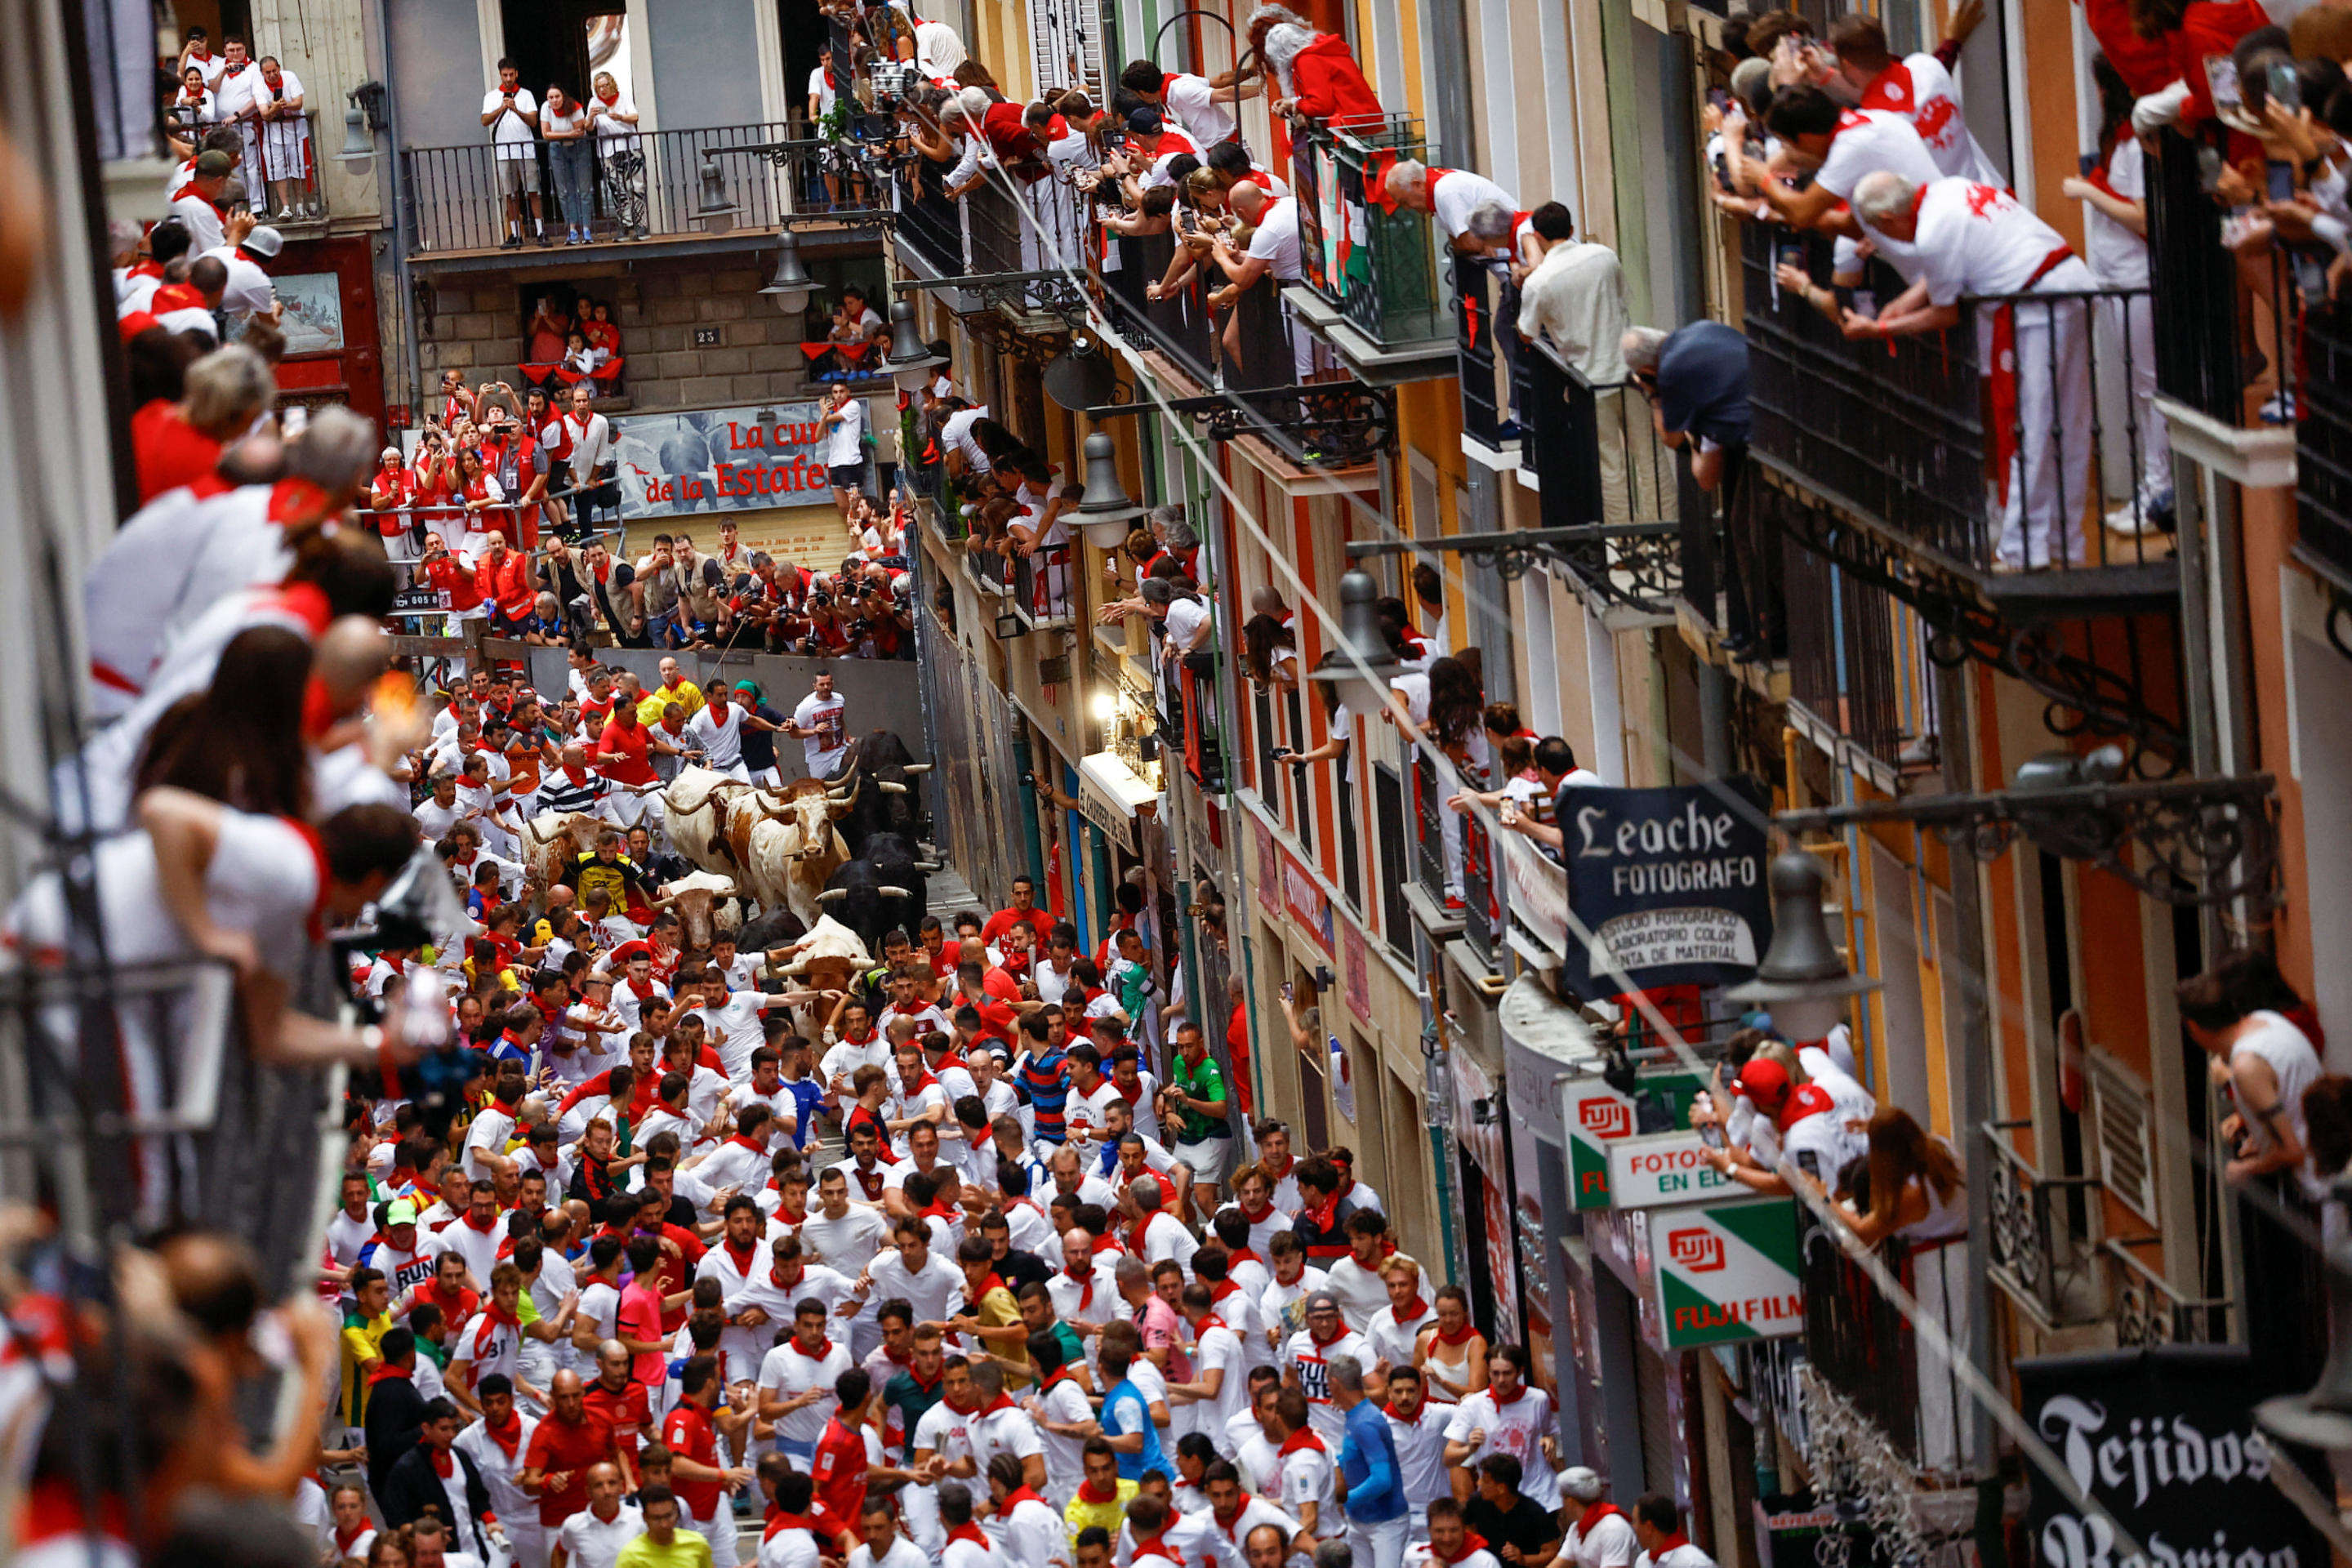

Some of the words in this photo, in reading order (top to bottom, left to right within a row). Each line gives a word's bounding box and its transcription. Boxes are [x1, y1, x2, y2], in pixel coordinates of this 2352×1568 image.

[728, 421, 764, 450] La
[773, 421, 823, 447] cur
[646, 478, 673, 502] de
[680, 475, 703, 500] la
[1577, 799, 1735, 858] Leache
[1612, 856, 1757, 896] FOTOGRAFO
[1606, 927, 1688, 955] LABORATORIO
[1694, 927, 1736, 944] COLOR
[1651, 946, 1668, 963] DE
[1676, 942, 1738, 963] MATERIAL
[1579, 1096, 1631, 1139] FUJI
[1659, 1174, 1688, 1193] EN
[1668, 1227, 1726, 1273] FUJI
[396, 1260, 434, 1290] RUN
[2039, 1395, 2273, 1508] Tejidos
